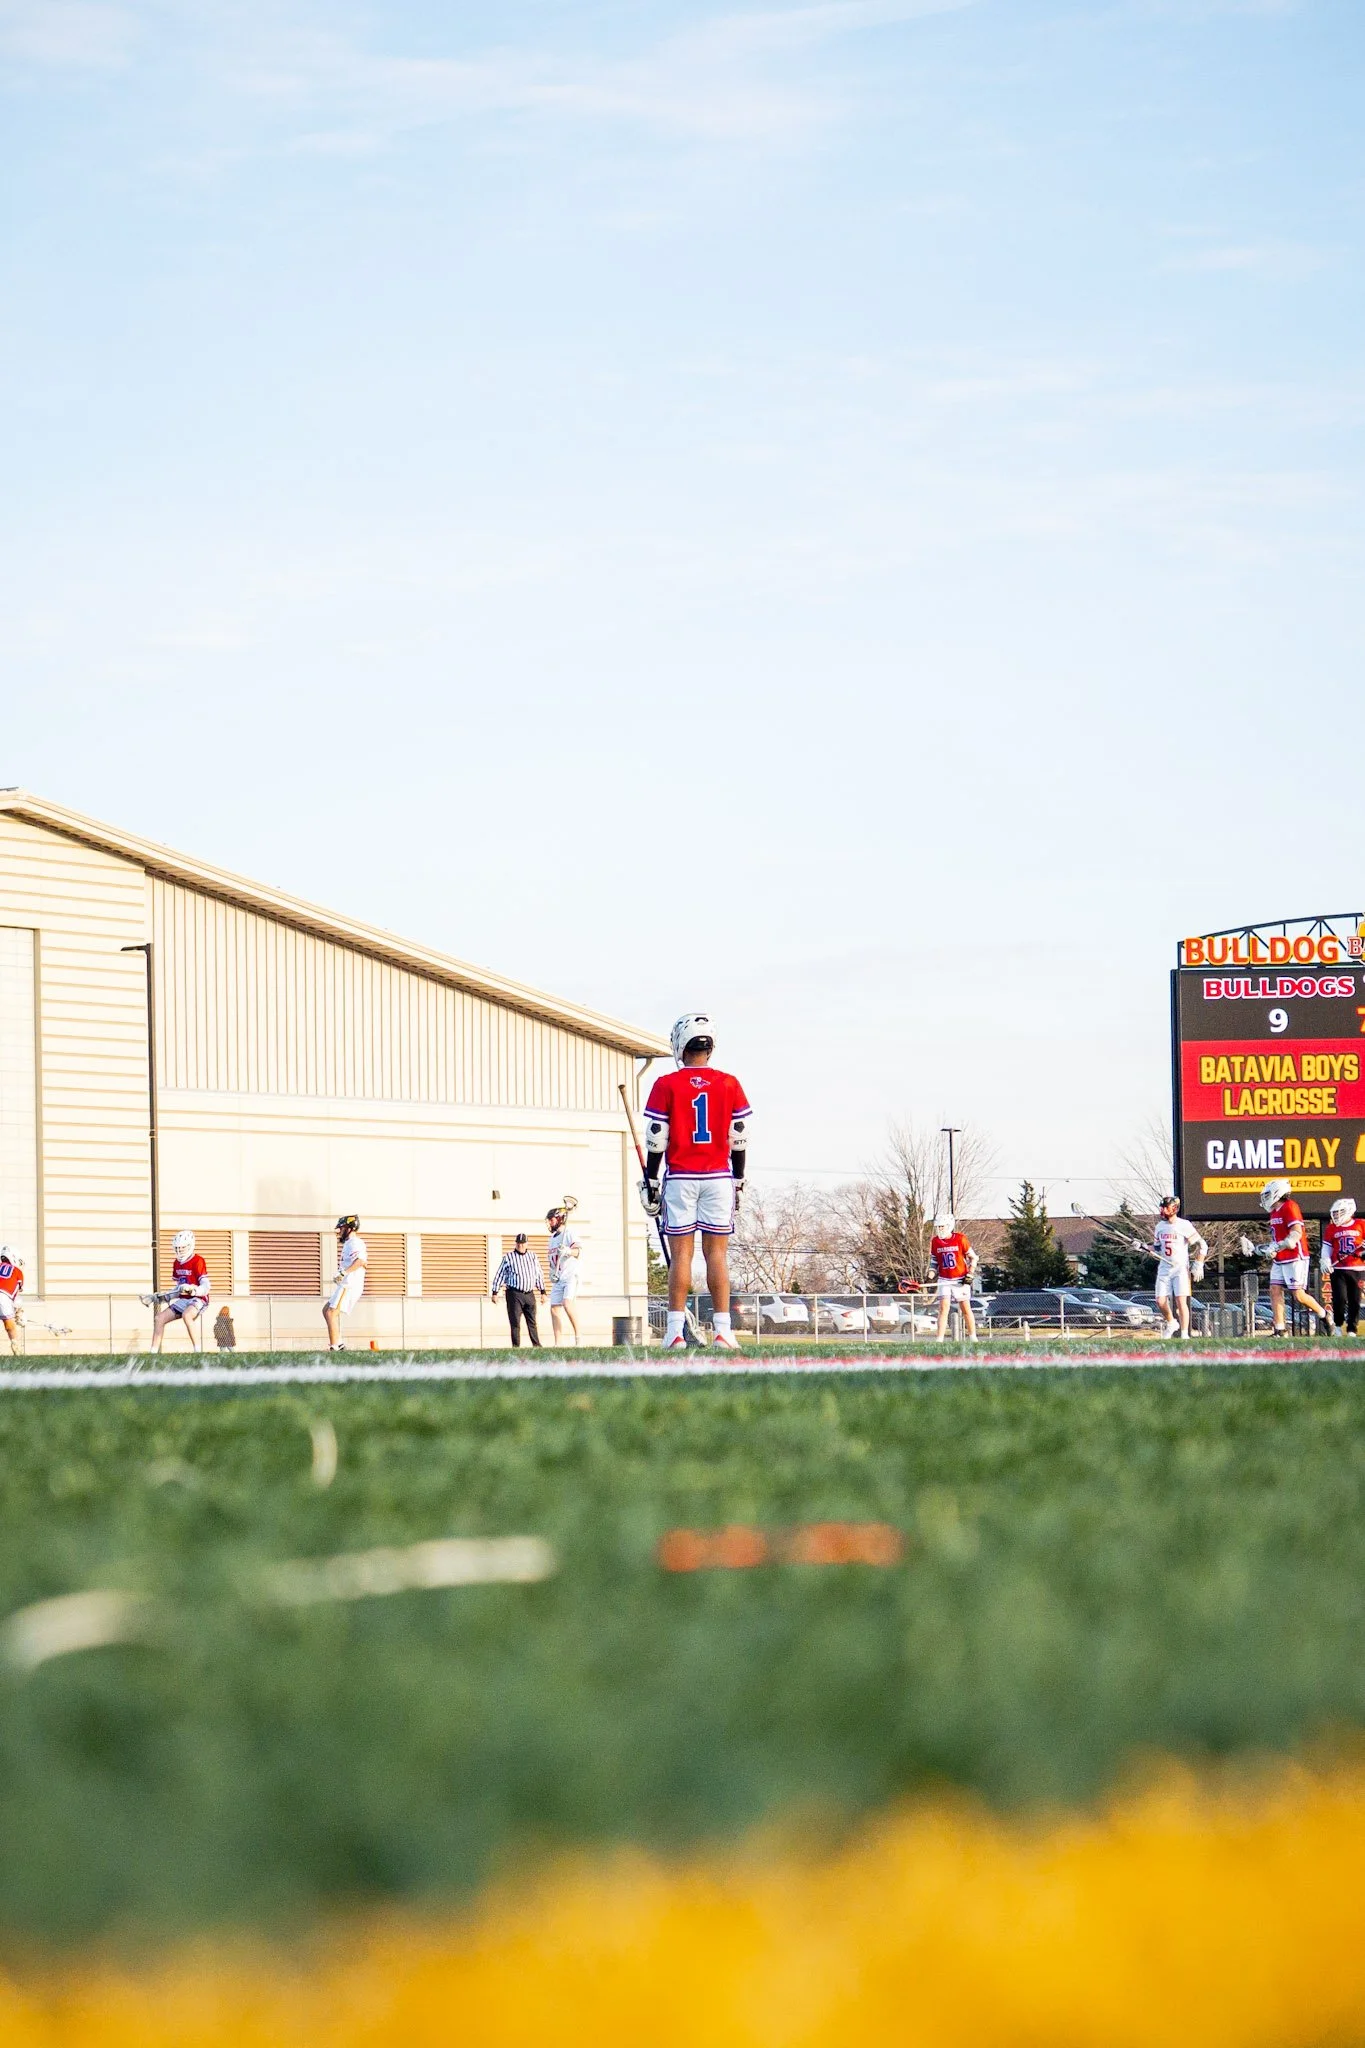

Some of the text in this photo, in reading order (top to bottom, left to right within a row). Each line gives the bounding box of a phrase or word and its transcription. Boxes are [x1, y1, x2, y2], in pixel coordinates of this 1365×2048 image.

[1184, 935, 1340, 965] BULLDOG
[1203, 976, 1355, 999] BULLDOGS
[1268, 1008, 1289, 1033] 9
[1200, 1053, 1359, 1084] BATAVIA BOYS
[1223, 1086, 1338, 1116] LACROSSE
[692, 1092, 712, 1143] 1
[1220, 1179, 1325, 1189] BATAVIA LETICS
[1164, 1240, 1172, 1257] 5
[1339, 1236, 1355, 1254] 15
[942, 1252, 956, 1269] 16
